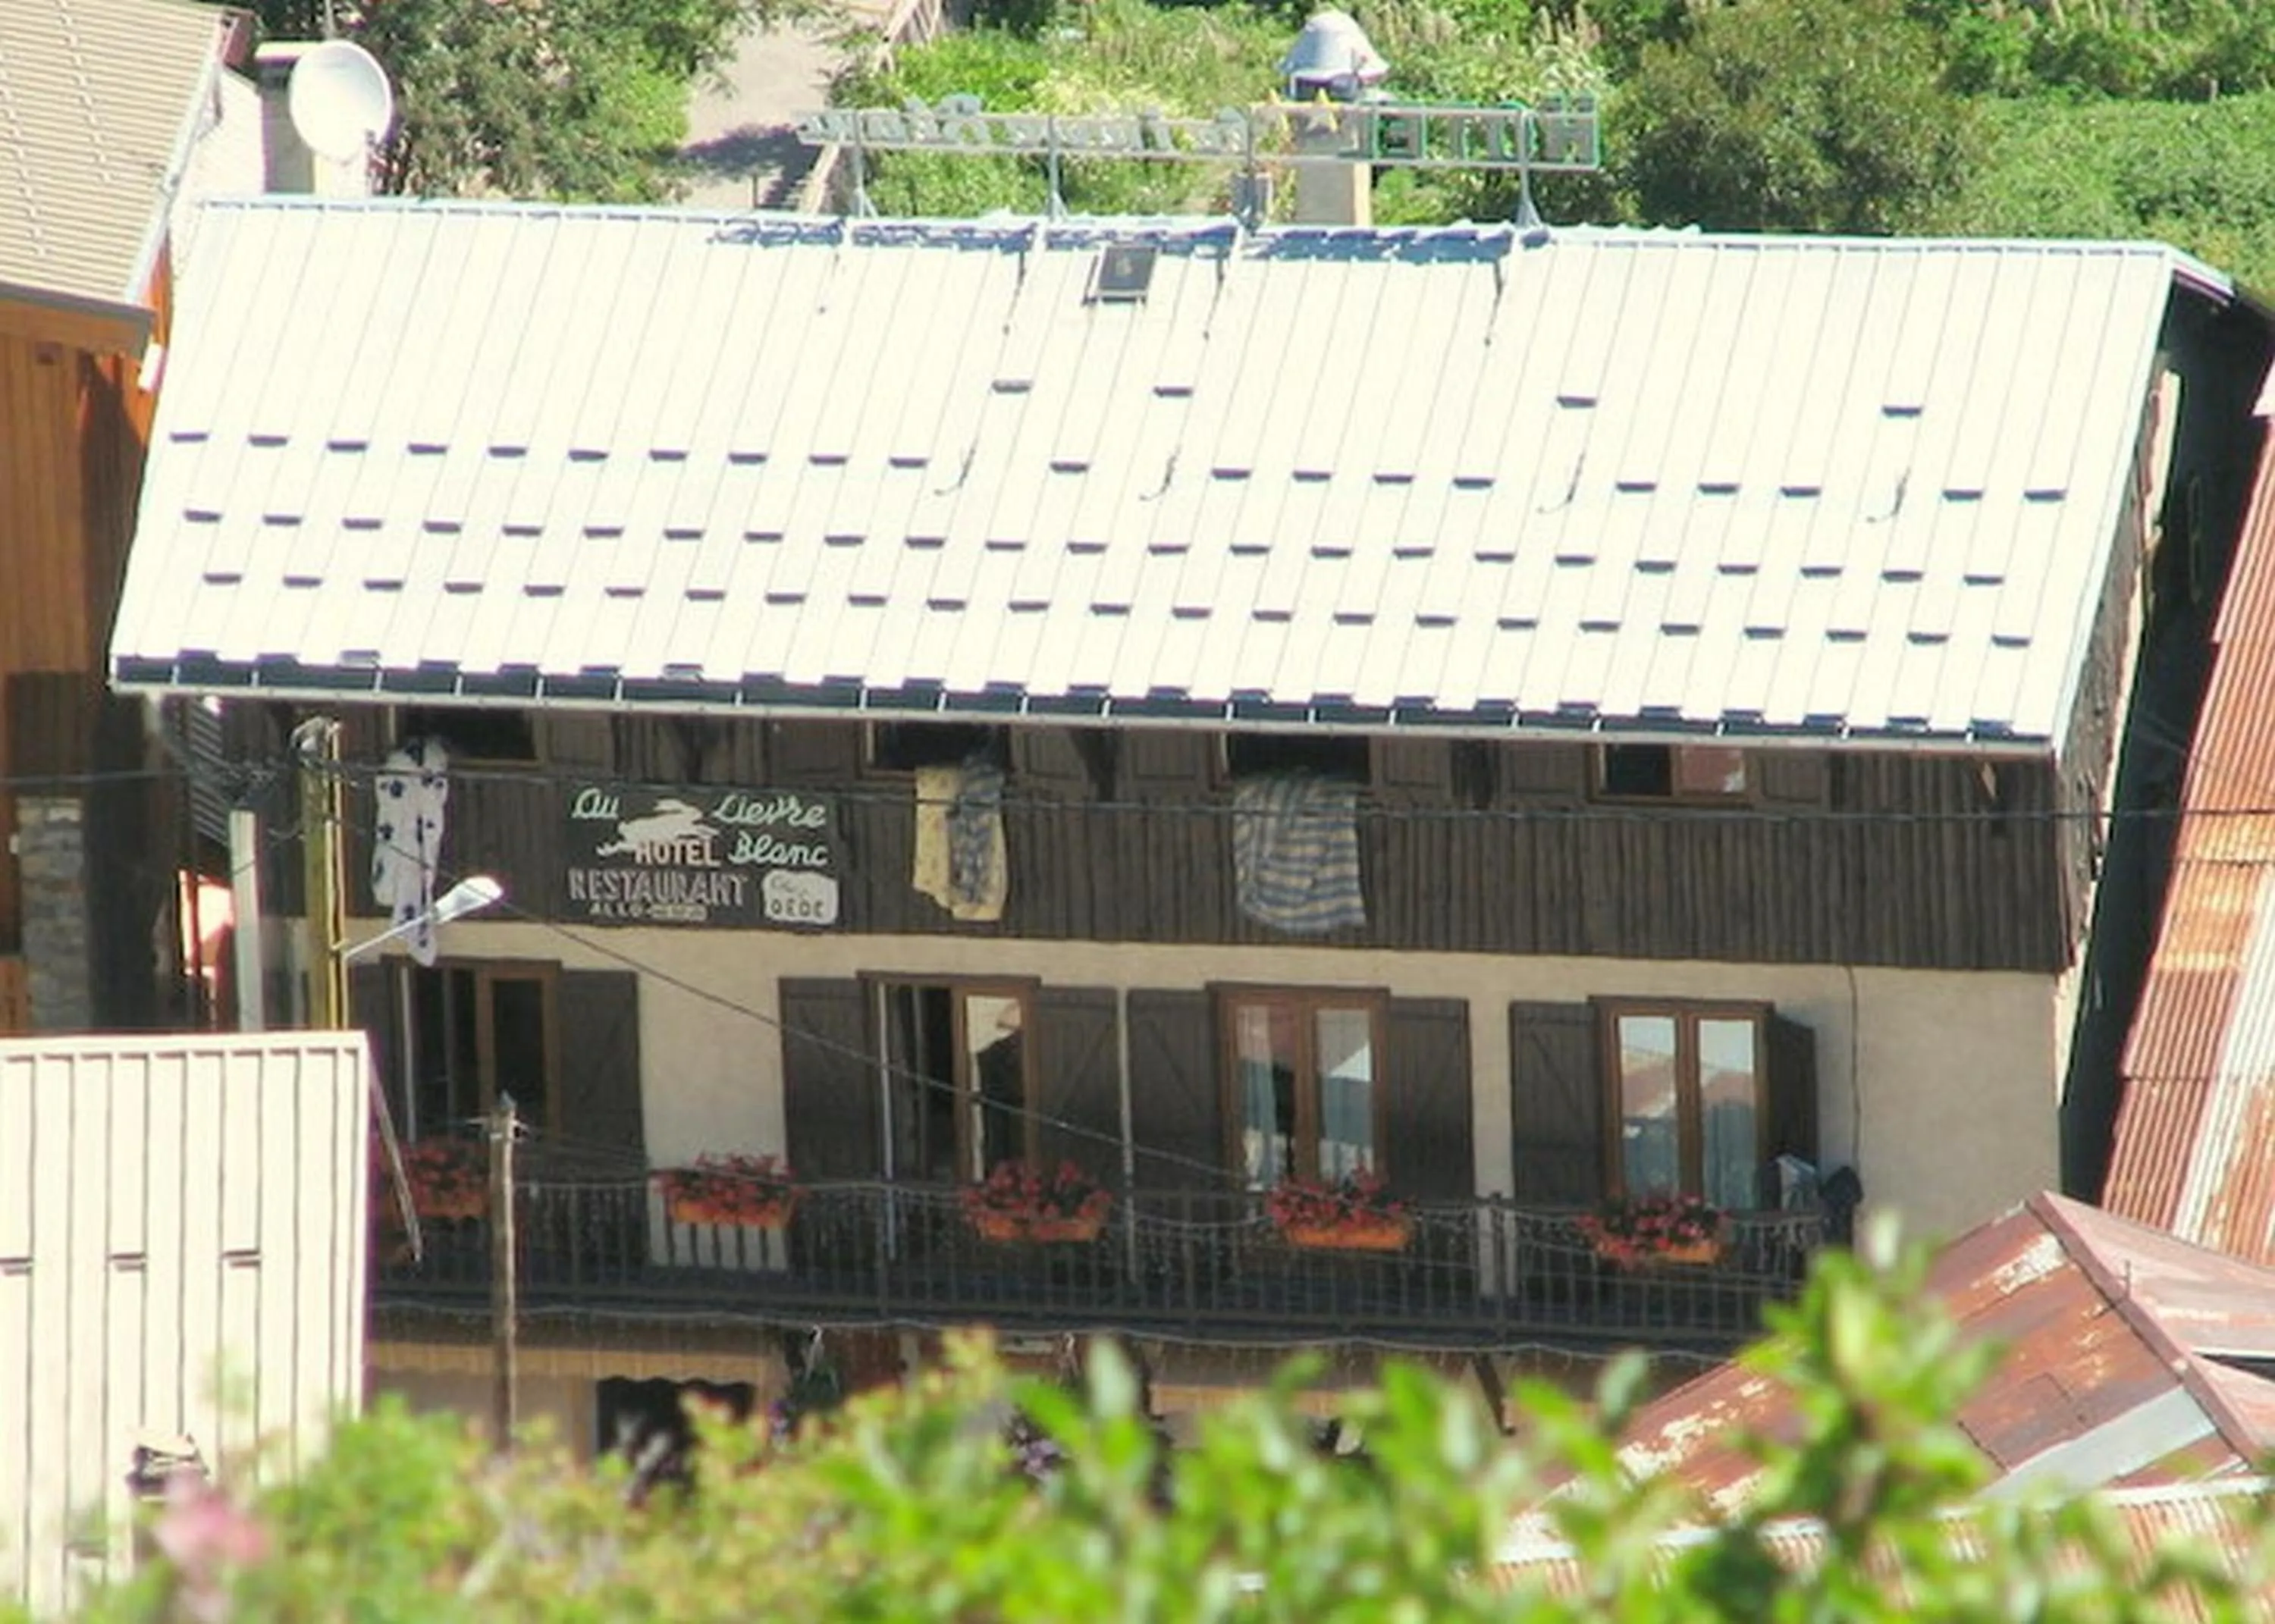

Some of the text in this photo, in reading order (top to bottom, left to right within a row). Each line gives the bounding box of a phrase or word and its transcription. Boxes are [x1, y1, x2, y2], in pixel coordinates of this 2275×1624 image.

[571, 787, 620, 820] Au
[635, 831, 828, 867] HOTEL Blanc
[568, 868, 748, 906] RESTAURANT
